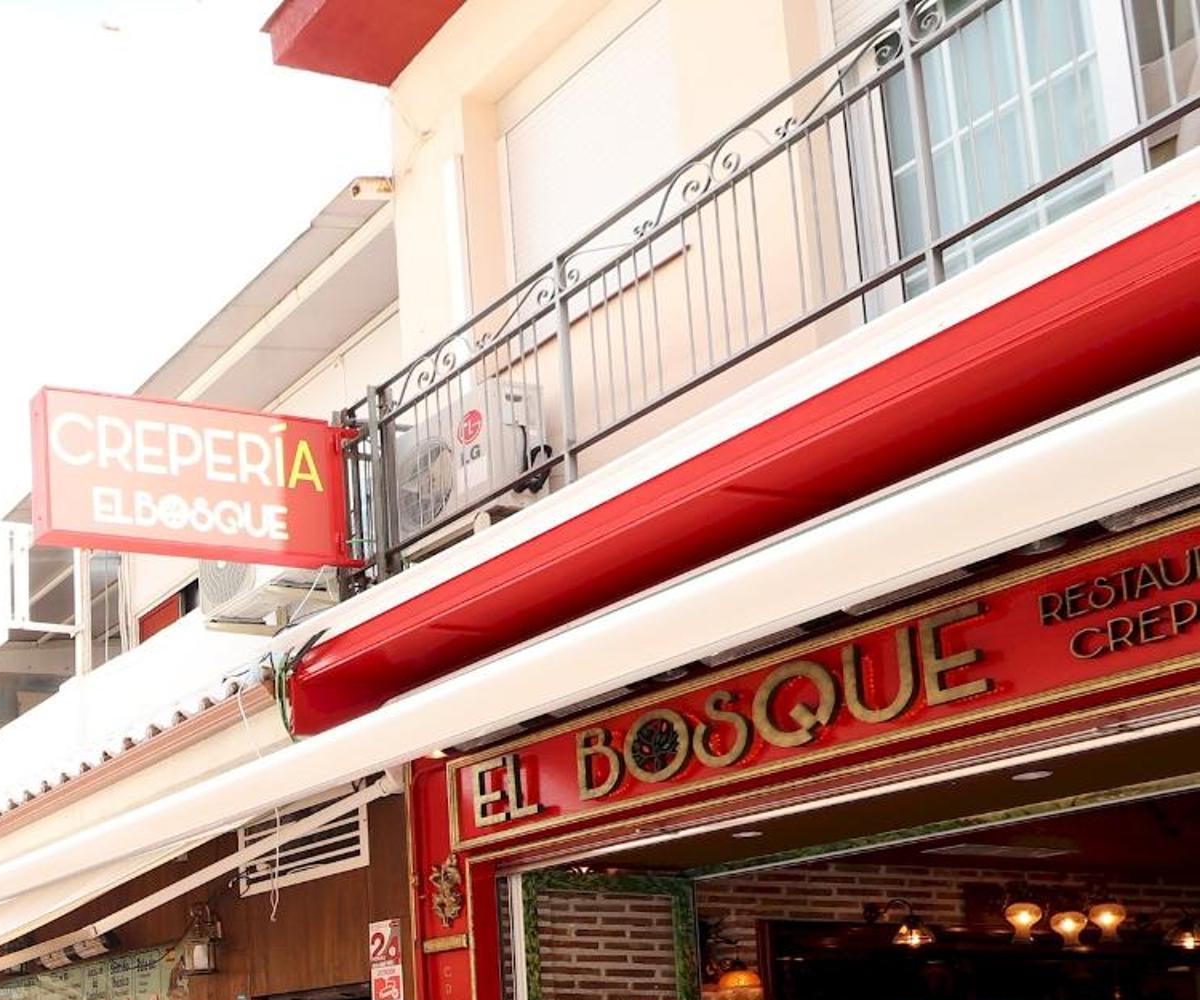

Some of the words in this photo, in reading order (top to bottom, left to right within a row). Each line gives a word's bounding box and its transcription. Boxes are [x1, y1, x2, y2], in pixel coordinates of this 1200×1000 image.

[50, 411, 325, 493] CREPERÍA
[1069, 599, 1199, 660] CREP
[472, 753, 539, 828] EL
[575, 600, 990, 802] BOSQUE
